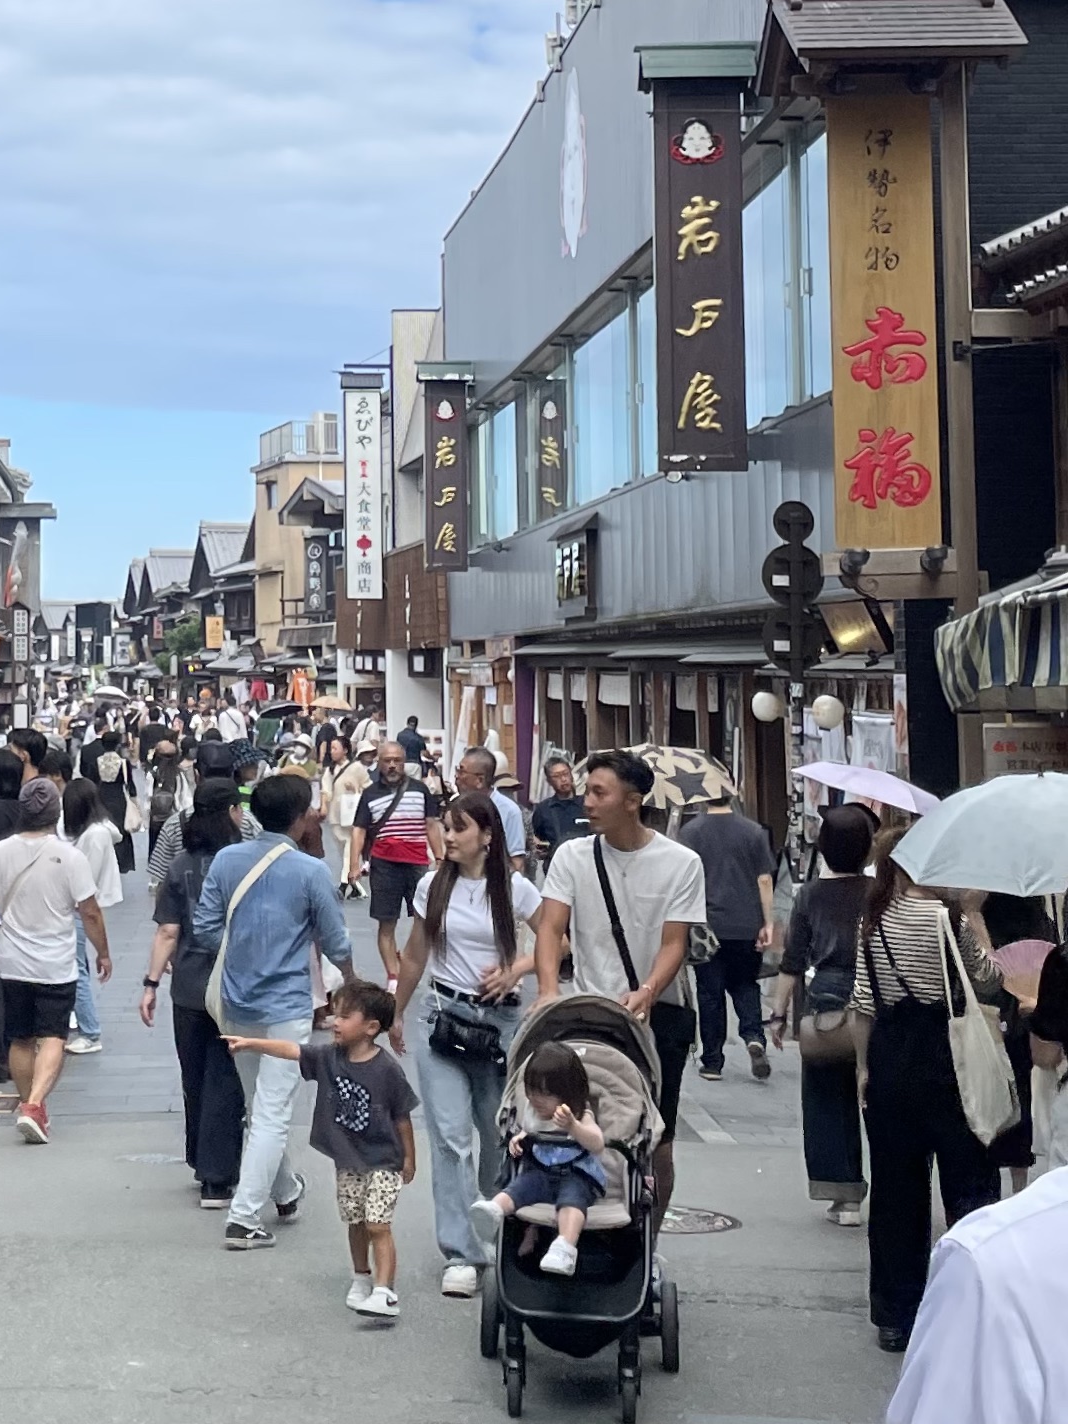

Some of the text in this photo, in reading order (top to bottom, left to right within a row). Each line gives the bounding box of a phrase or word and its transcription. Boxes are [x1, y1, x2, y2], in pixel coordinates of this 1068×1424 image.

[865, 128, 900, 272] 伊勢名物
[676, 195, 723, 433] 岩戸屋
[842, 307, 932, 509] 赤福
[355, 397, 373, 594] ゑびや 大食堂 商店
[434, 436, 457, 553] 岩戸屋
